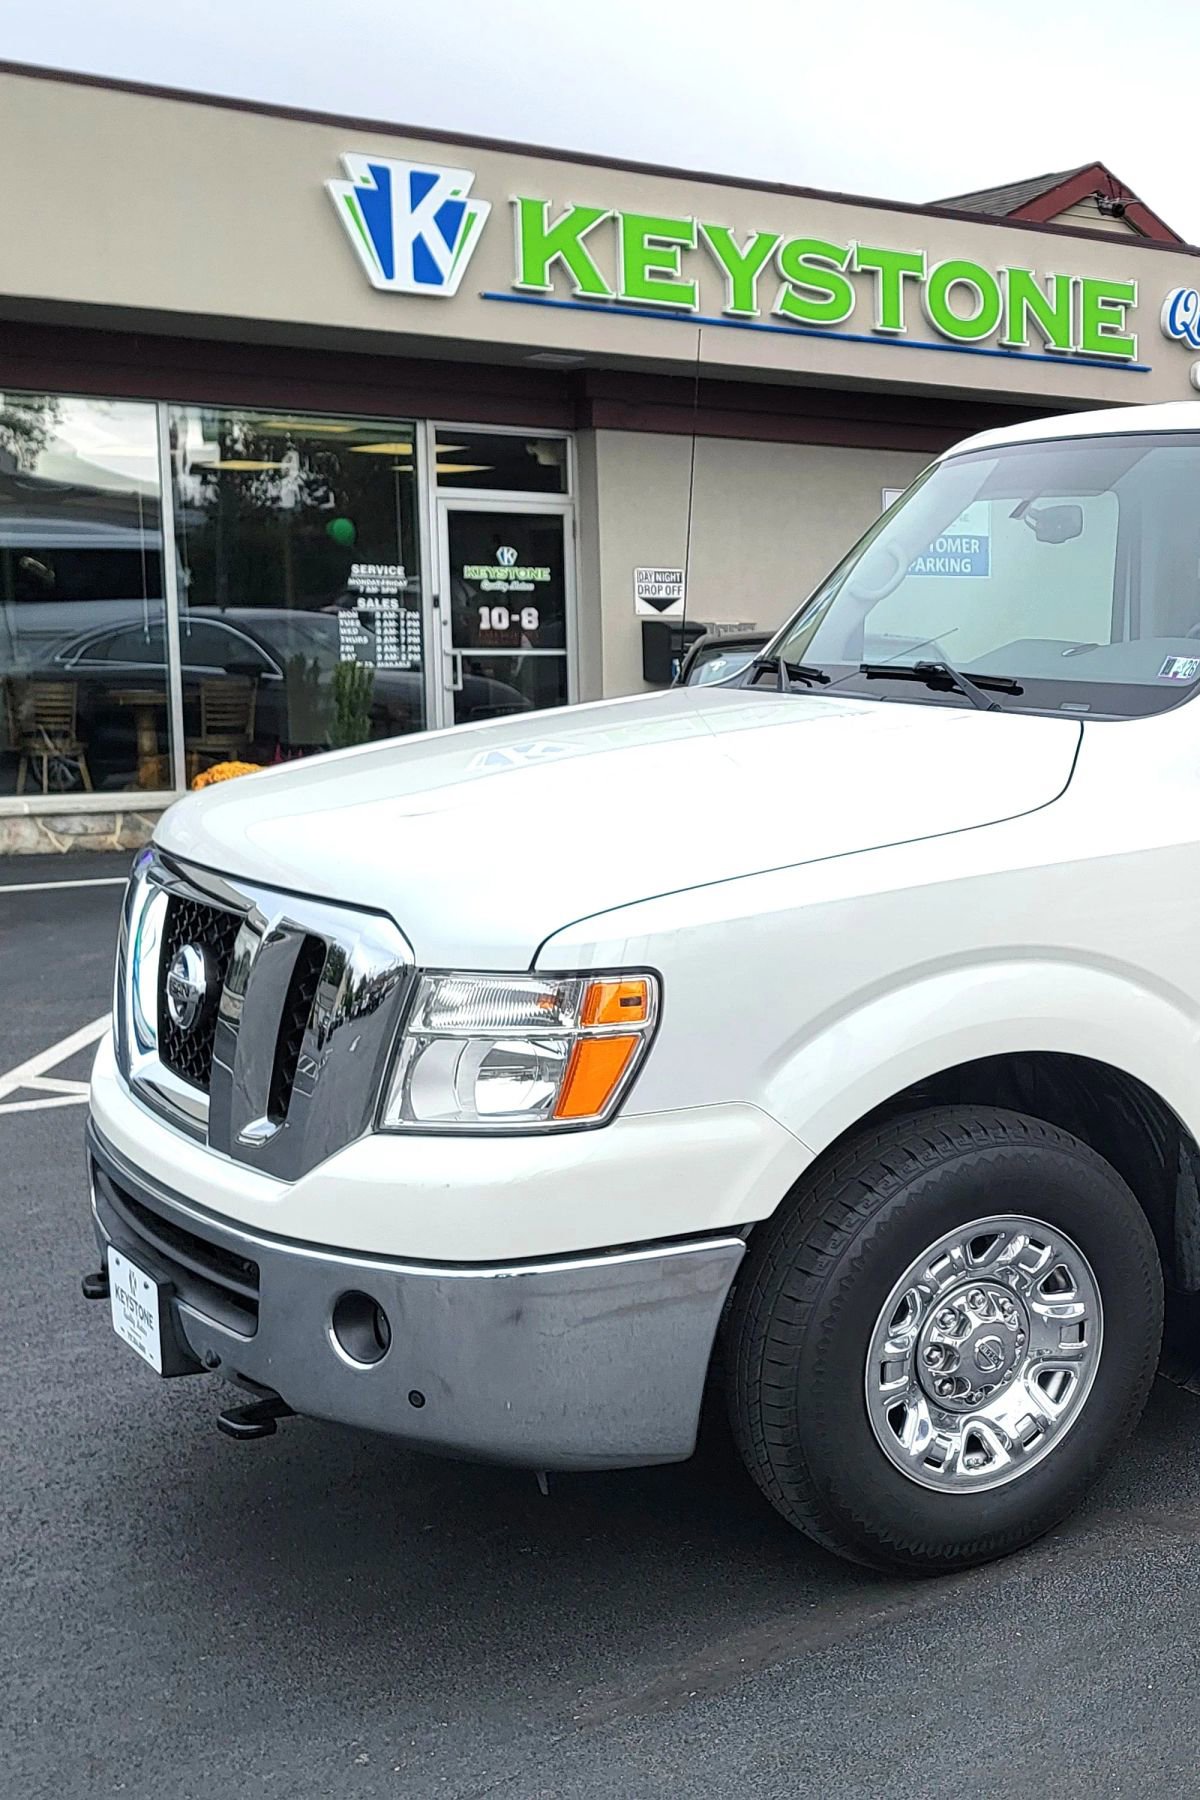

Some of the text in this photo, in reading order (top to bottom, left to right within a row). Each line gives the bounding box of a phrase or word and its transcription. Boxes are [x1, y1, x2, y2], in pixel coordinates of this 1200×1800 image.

[510, 195, 1139, 361] KEYSTONE
[351, 564, 405, 576] SERVICE
[463, 565, 551, 581] KEYSTONE
[637, 571, 681, 583] DAY NIGHT
[637, 585, 683, 596] DROP OFF
[357, 597, 399, 609] SALES
[478, 606, 539, 630] 10-8
[114, 1283, 154, 1330] KEYSTONE
